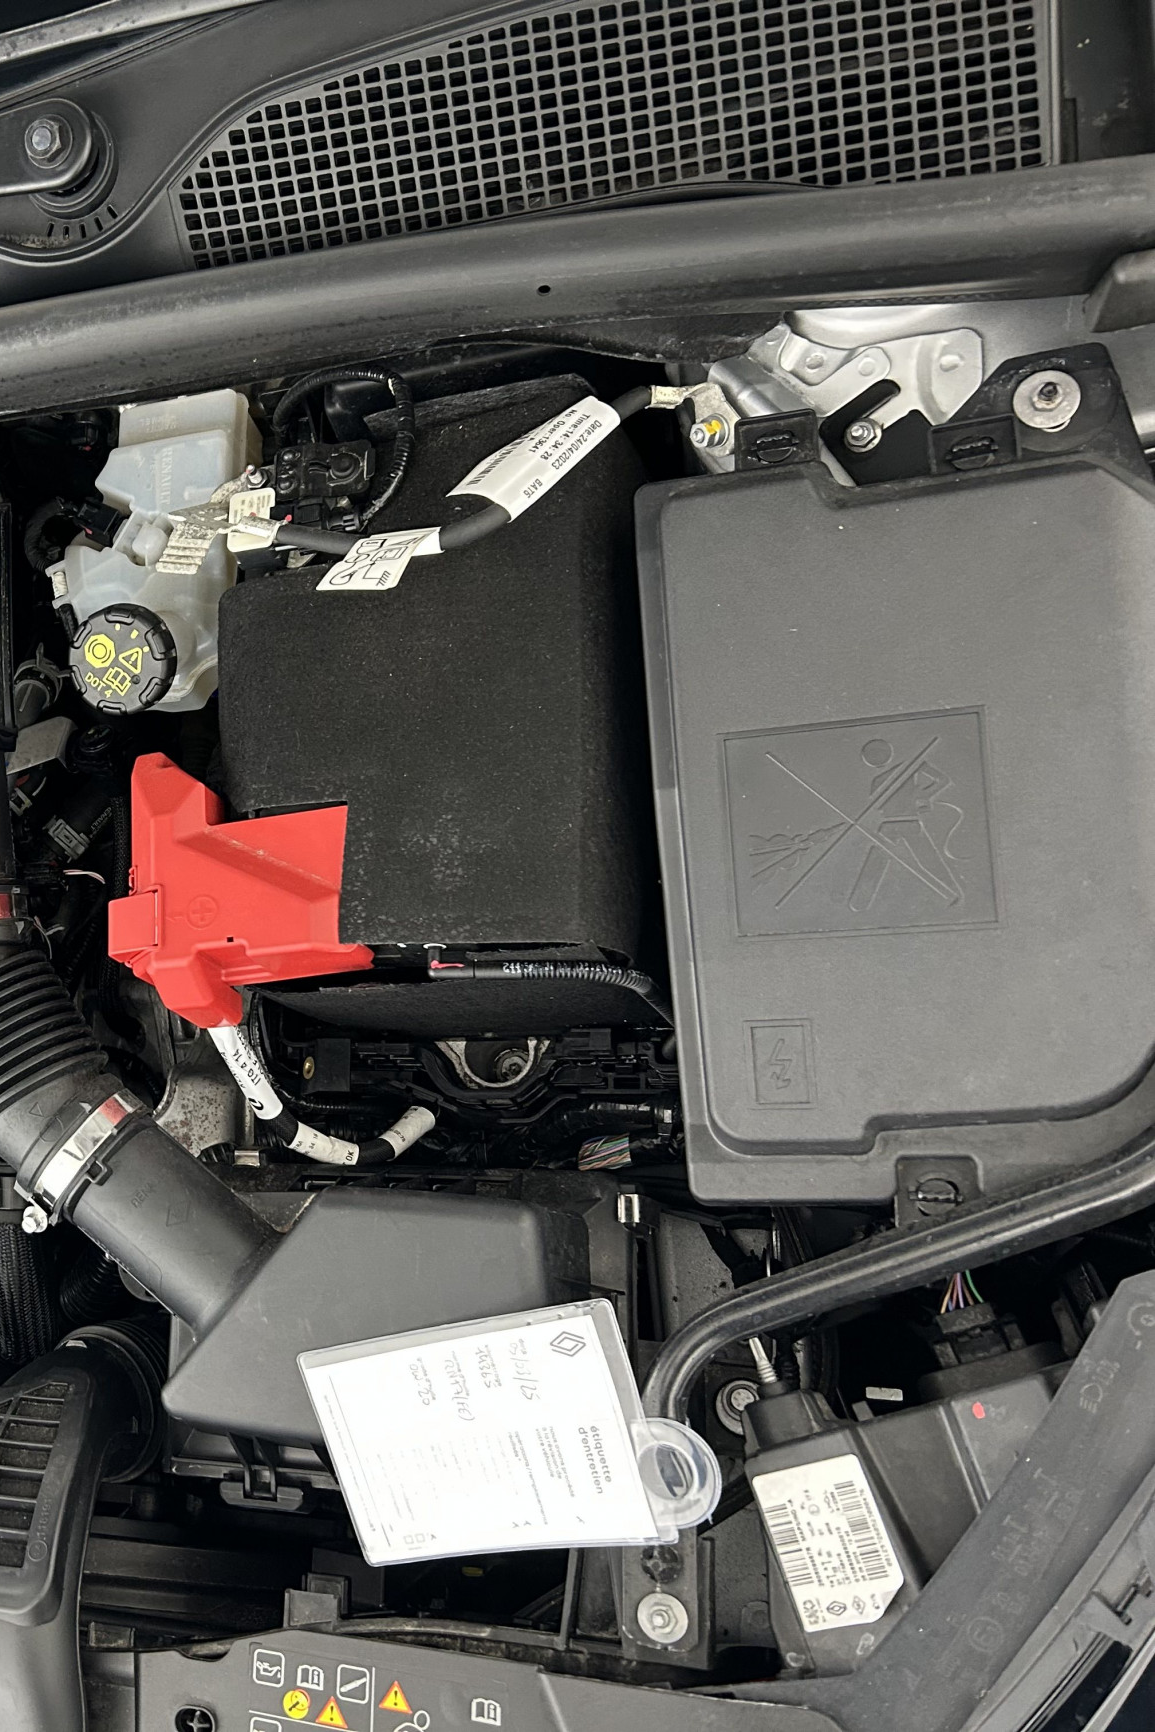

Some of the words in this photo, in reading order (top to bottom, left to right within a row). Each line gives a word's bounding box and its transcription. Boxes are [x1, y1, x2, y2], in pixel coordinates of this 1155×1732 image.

[539, 449, 551, 461] 28
[551, 419, 602, 469] Date:24/04/2023
[84, 671, 106, 692] DOT
[103, 687, 113, 698] 4
[546, 1439, 559, 1468] révision
[555, 1469, 562, 1479] de
[549, 1425, 557, 1442] nous
[554, 1444, 564, 1465] avons
[589, 1425, 613, 1483] étiquette
